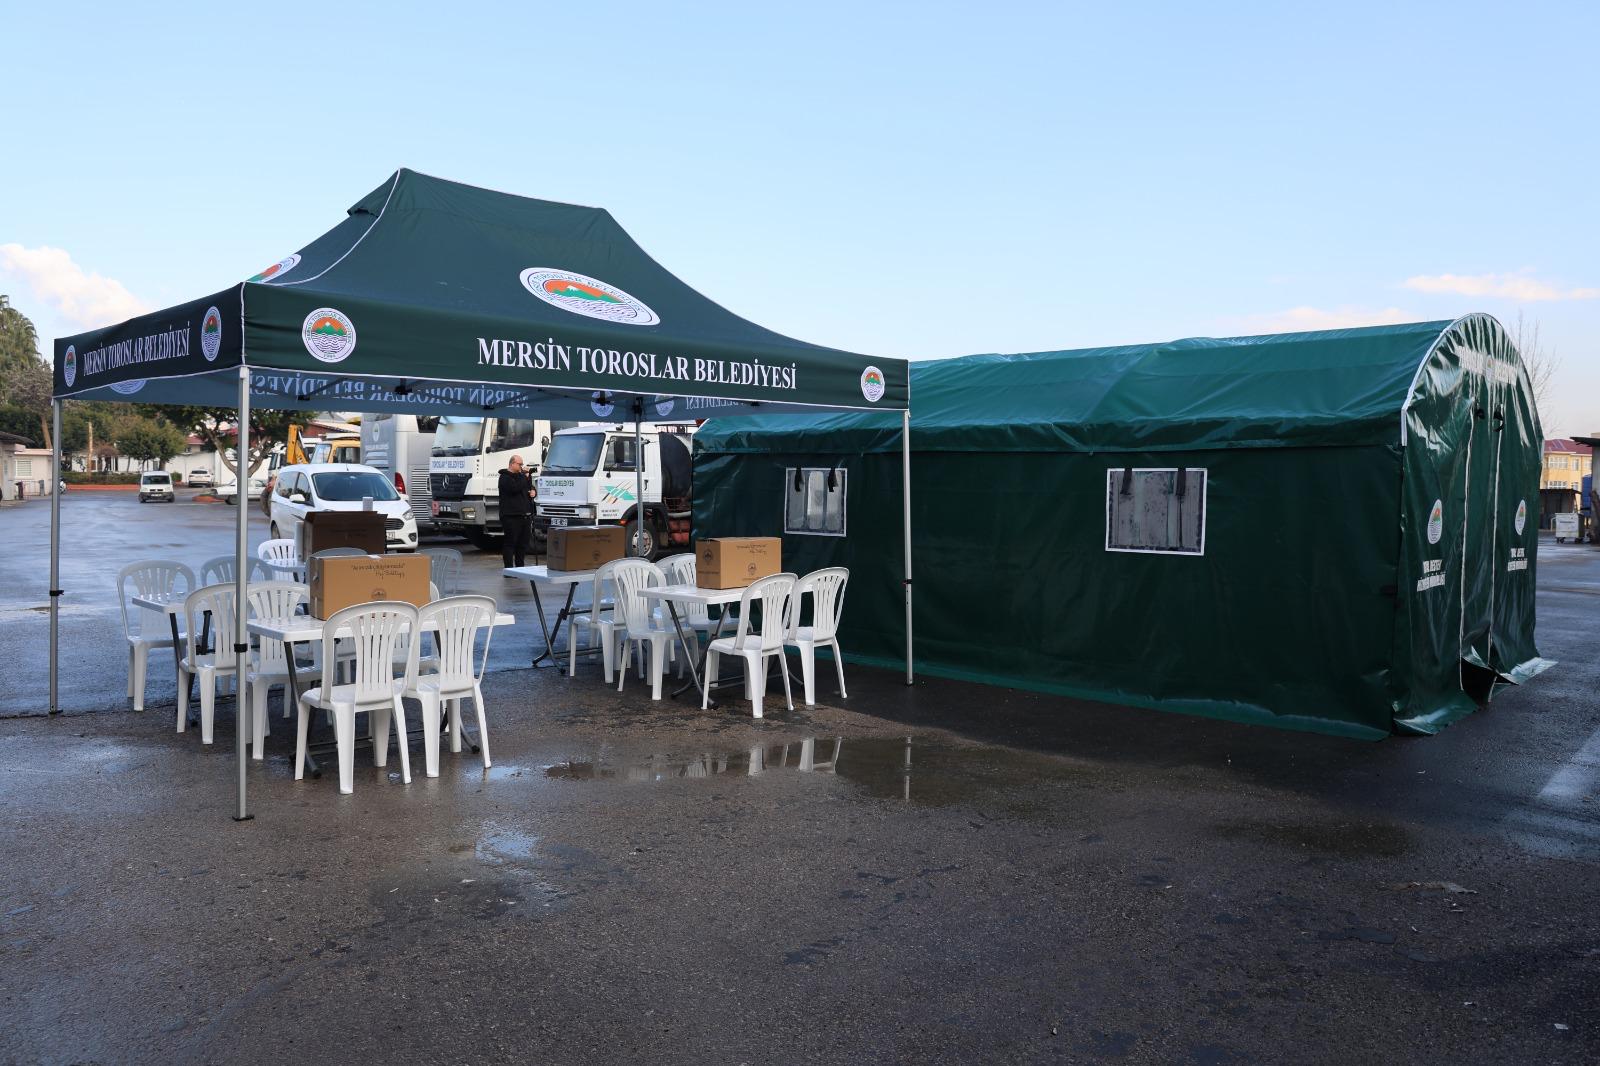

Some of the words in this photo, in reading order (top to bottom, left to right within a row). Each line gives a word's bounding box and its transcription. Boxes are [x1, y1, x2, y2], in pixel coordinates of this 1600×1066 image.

[83, 342, 107, 376] MERSİN
[107, 340, 144, 370] TOROSLAR
[144, 321, 190, 362] BELEDİYESİ
[477, 337, 571, 371] MERSİN
[577, 345, 690, 382] TOROSLAR
[694, 358, 797, 391] BELEDİYESİ
